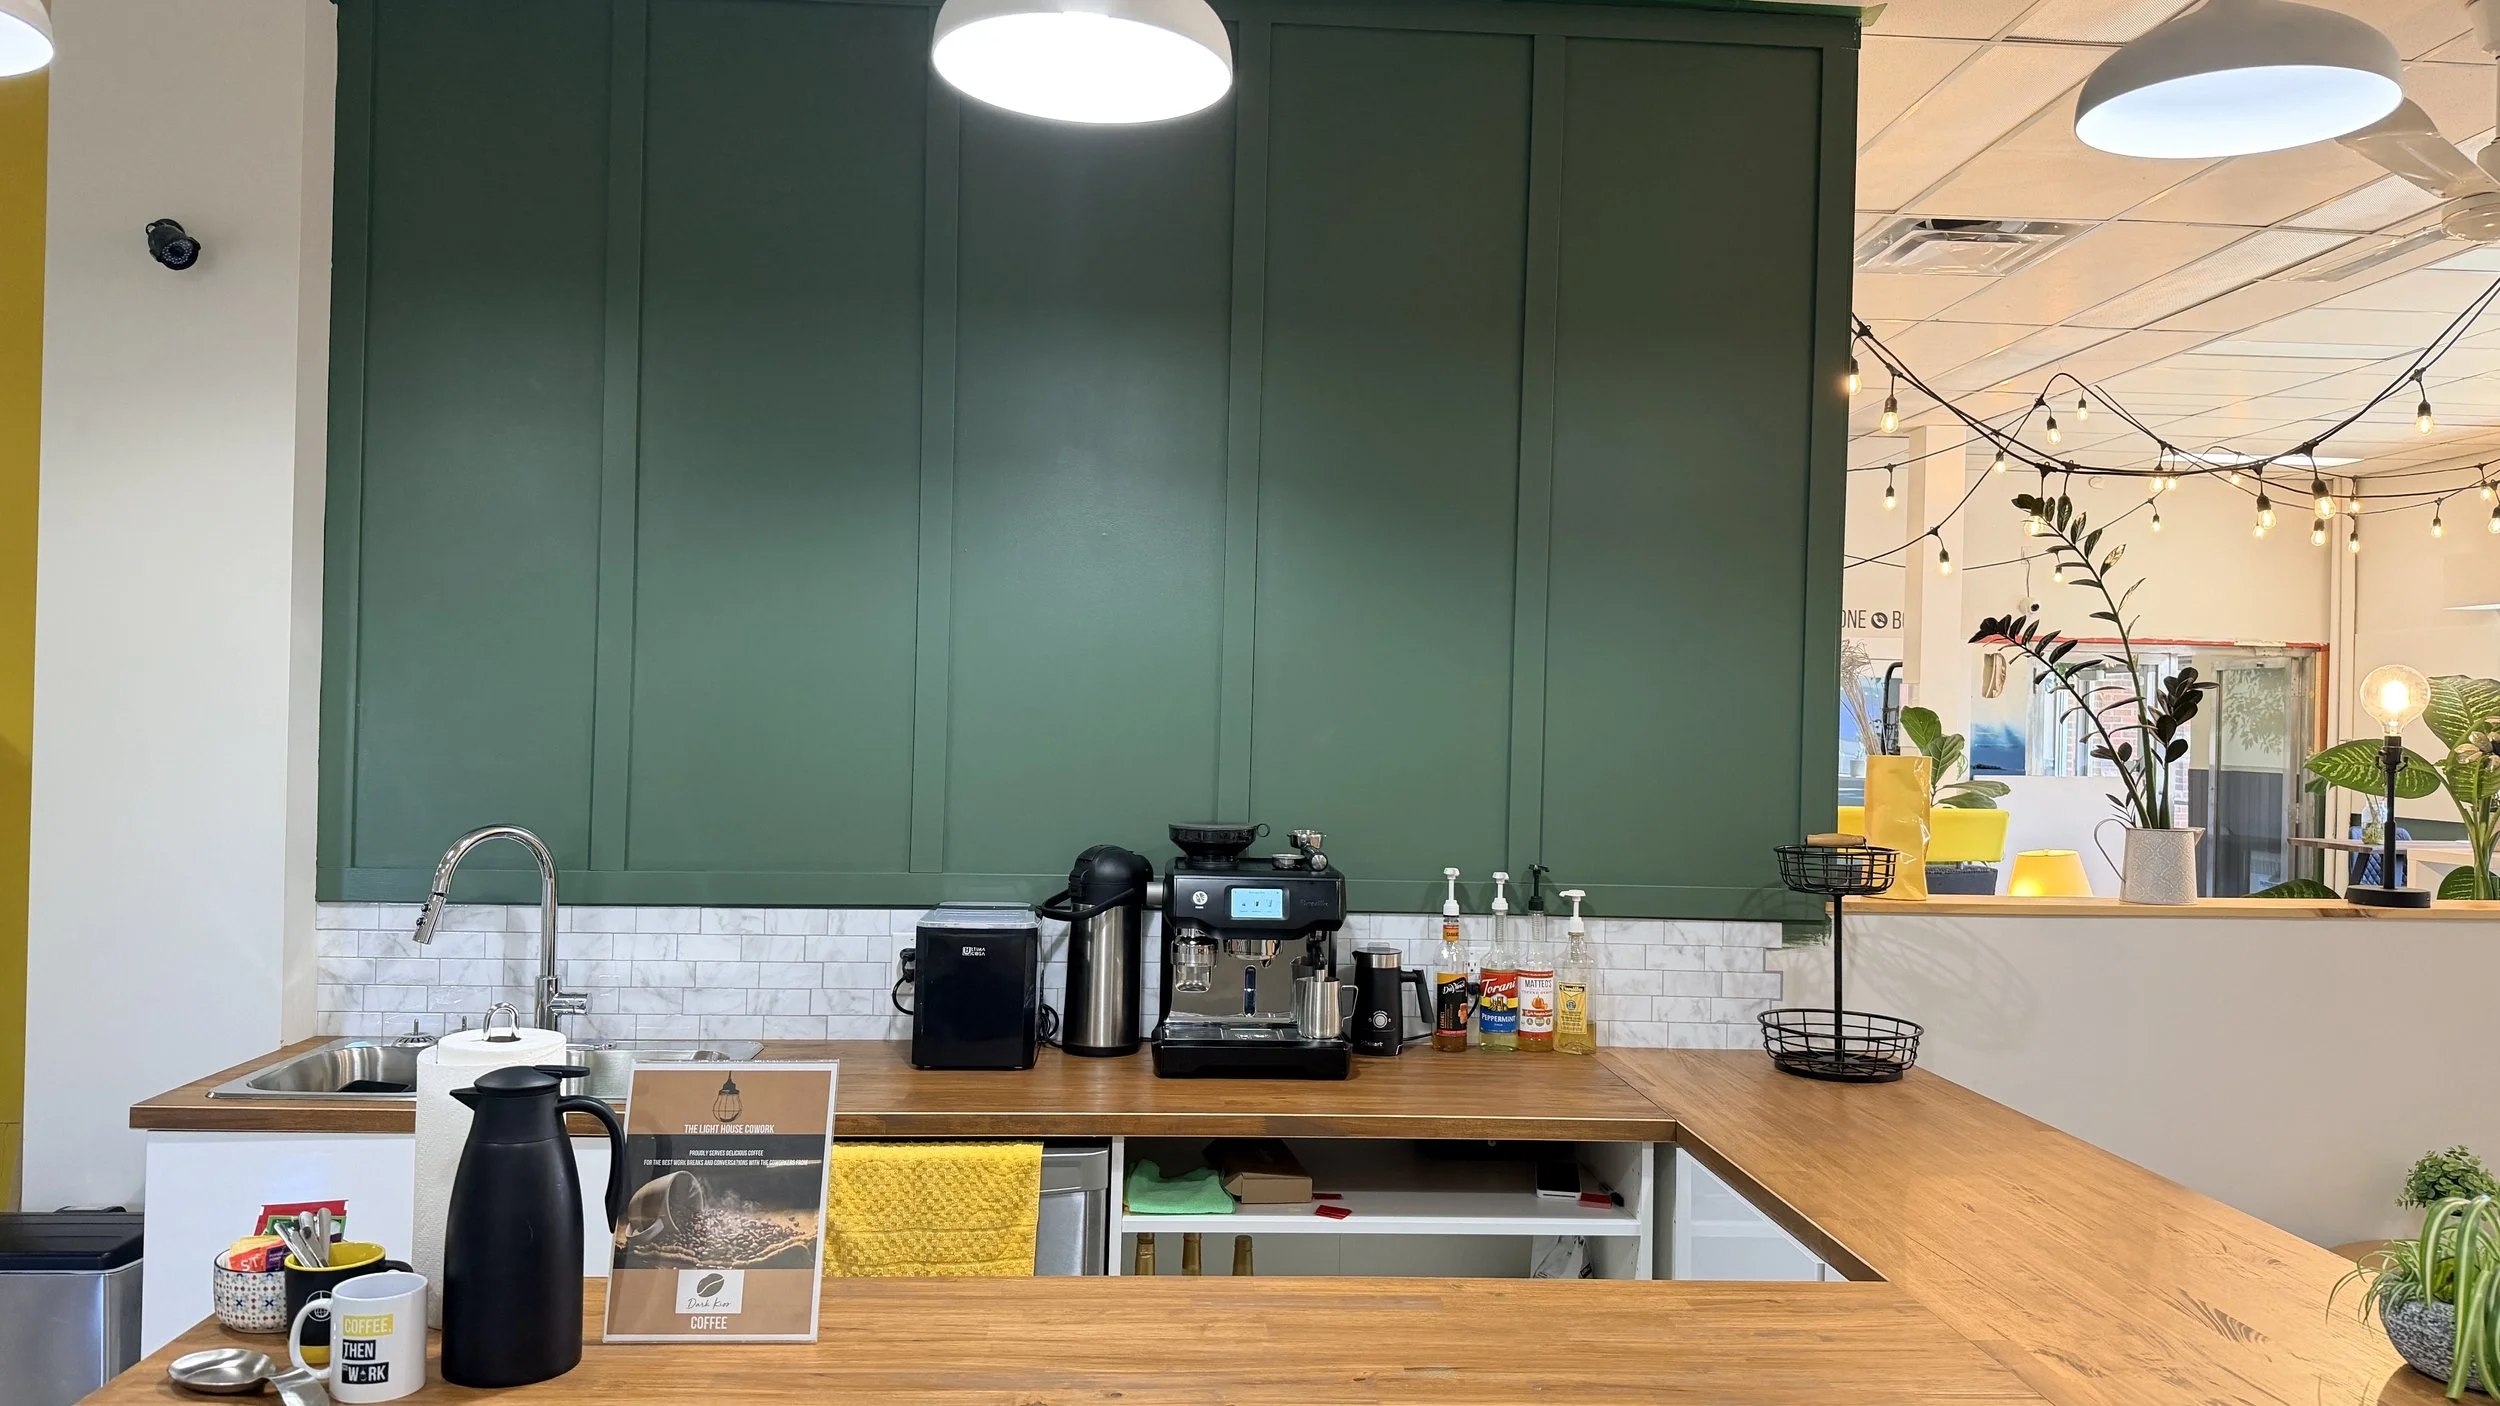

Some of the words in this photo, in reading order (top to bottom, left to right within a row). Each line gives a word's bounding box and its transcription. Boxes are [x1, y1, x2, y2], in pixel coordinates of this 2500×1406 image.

[1892, 610, 1904, 629] B
[1481, 977, 1517, 997] Torani
[1481, 1012, 1516, 1023] PEPPERMINT
[684, 1124, 699, 1134] THE
[700, 1124, 720, 1134] LIGHT
[720, 1124, 744, 1134] HOUSE
[744, 1124, 775, 1134] COWORK
[689, 1149, 709, 1157] PROUDLY
[709, 1149, 726, 1157] SERVES
[726, 1149, 748, 1157] DELICIOUS
[748, 1149, 764, 1157] COFFEE
[686, 1298, 710, 1310] Dark
[344, 1317, 392, 1334] COFFEE.
[690, 1316, 728, 1330] COFFEE
[343, 1341, 374, 1359] THEN
